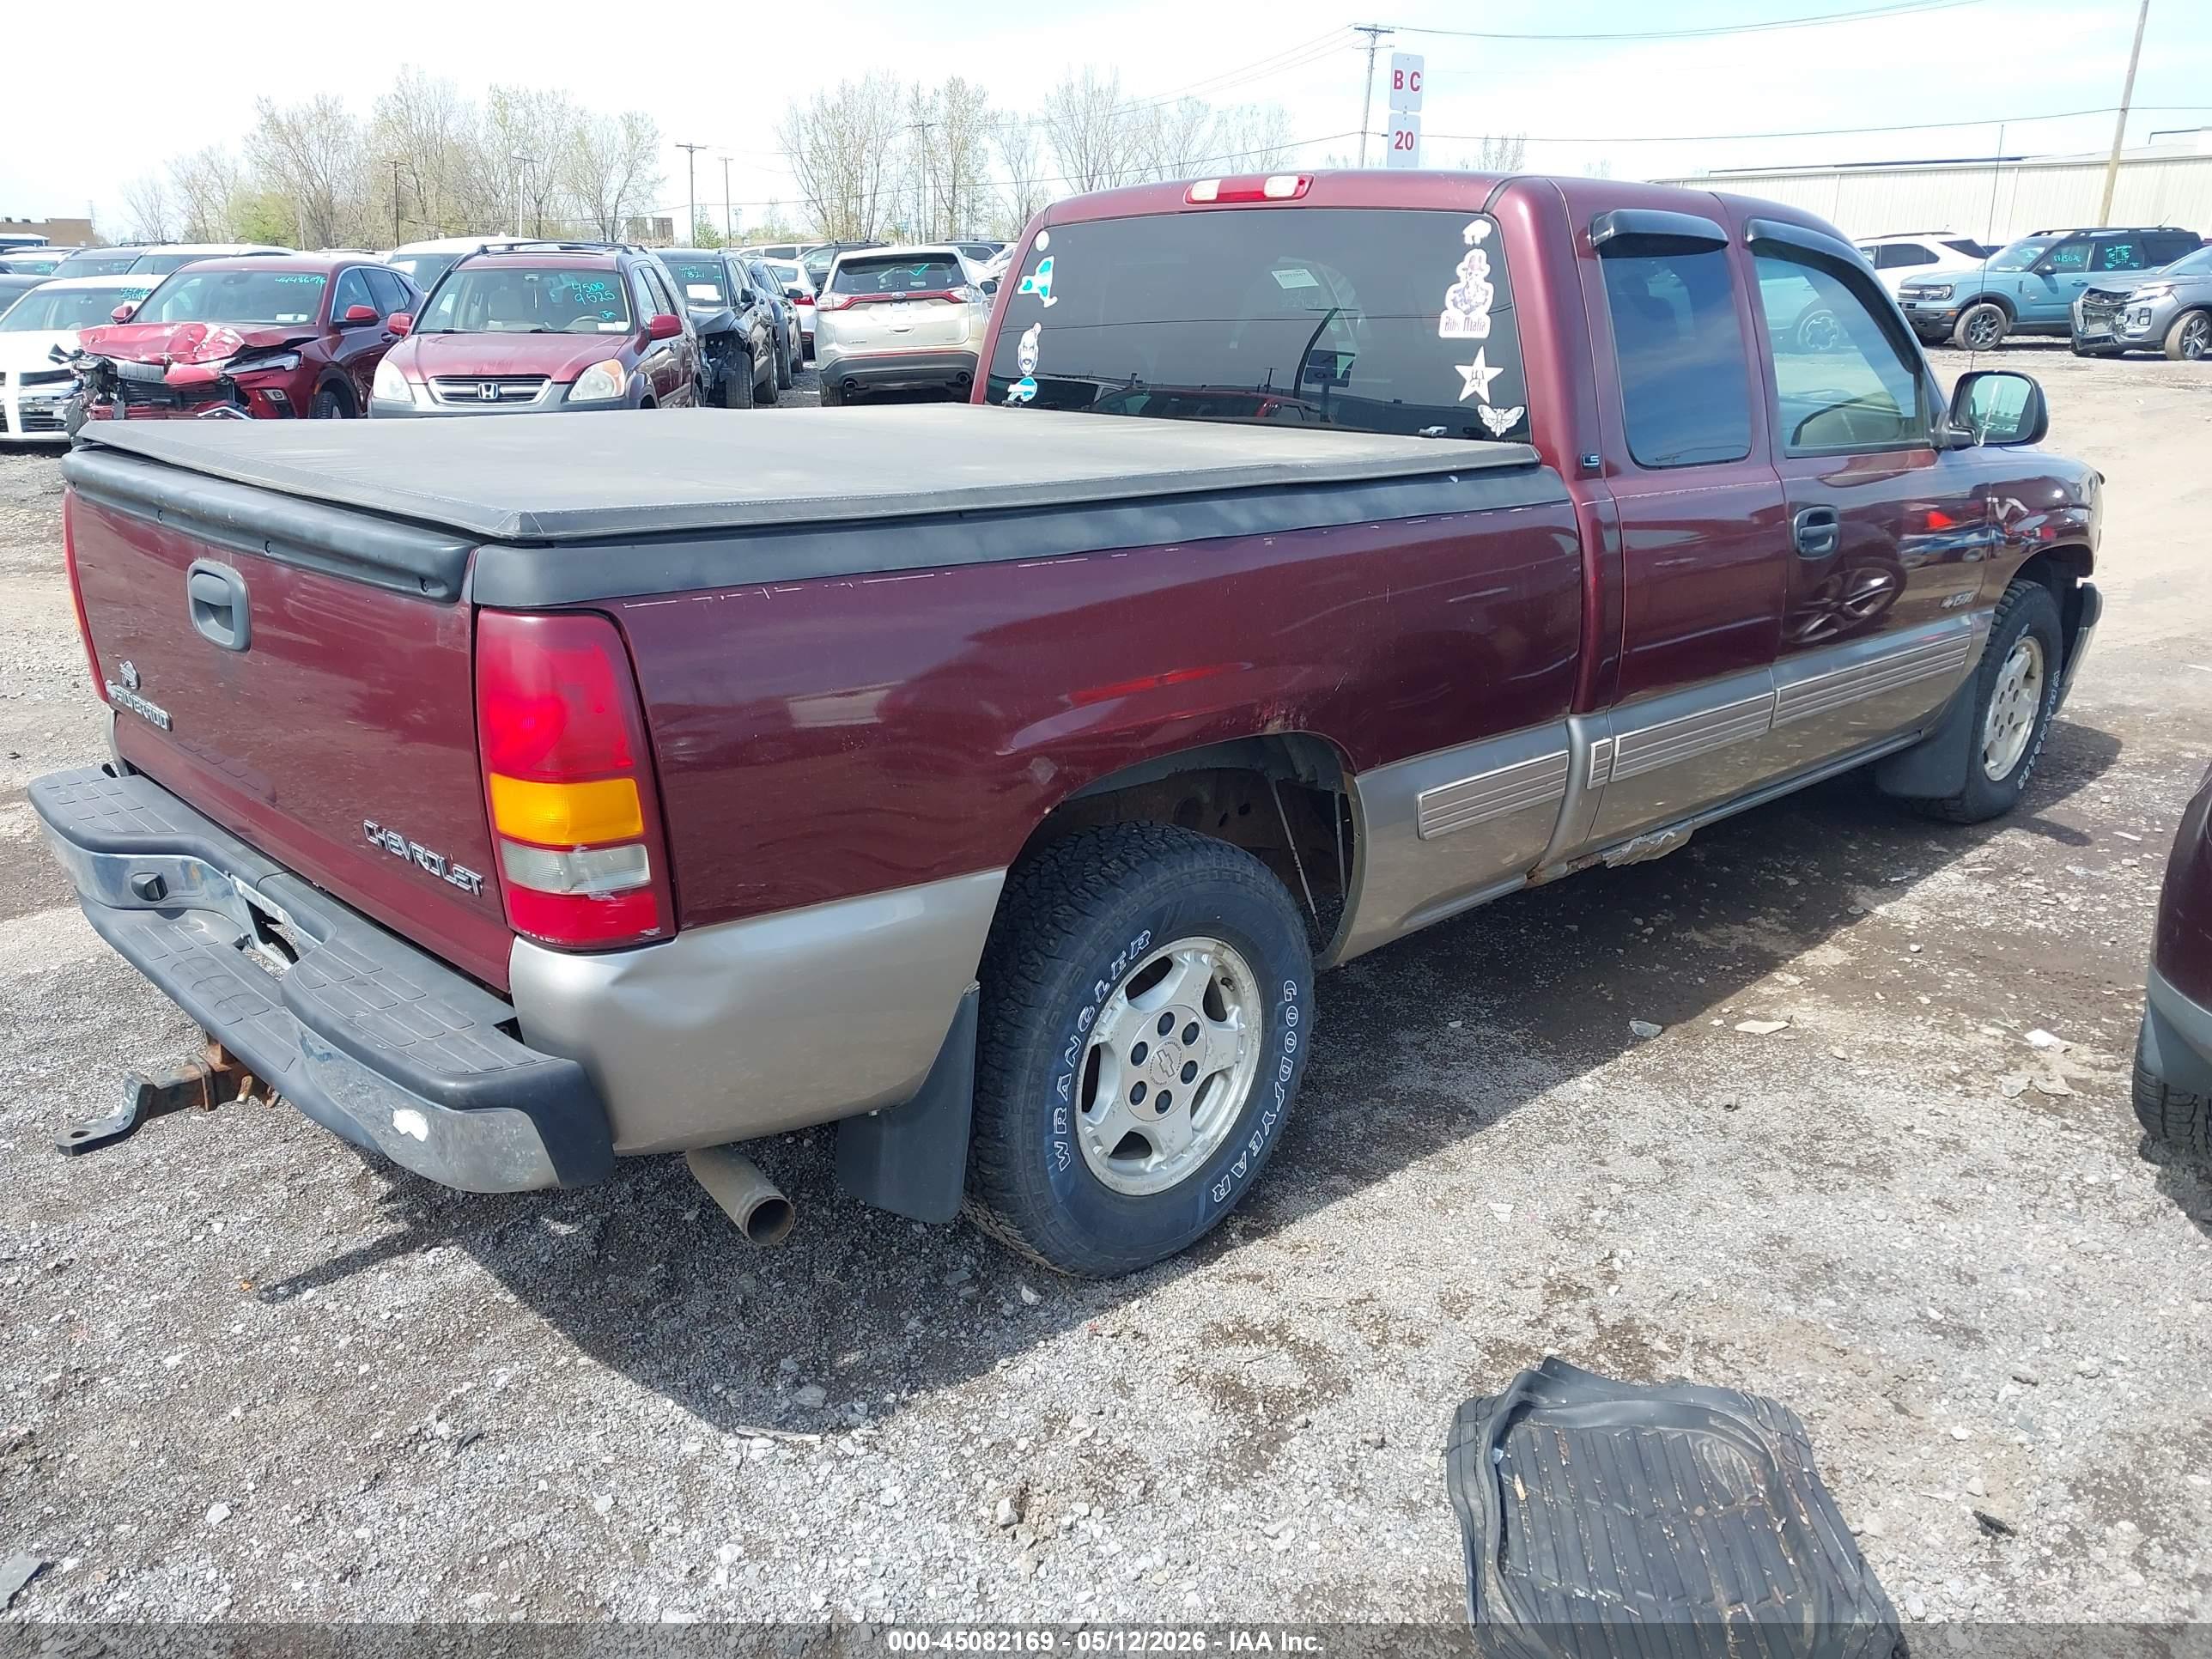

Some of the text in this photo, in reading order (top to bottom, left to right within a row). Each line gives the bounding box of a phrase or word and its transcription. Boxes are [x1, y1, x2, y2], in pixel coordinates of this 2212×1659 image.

[1394, 70, 1421, 92] B C
[1394, 131, 1414, 151] 20
[571, 282, 605, 293] 4500
[574, 289, 616, 305] 9525
[1583, 455, 1600, 466] LS
[363, 819, 484, 896] CHEVROLET
[1053, 929, 1152, 1172] WRANGLER
[1212, 979, 1299, 1203] GOODYEAR
